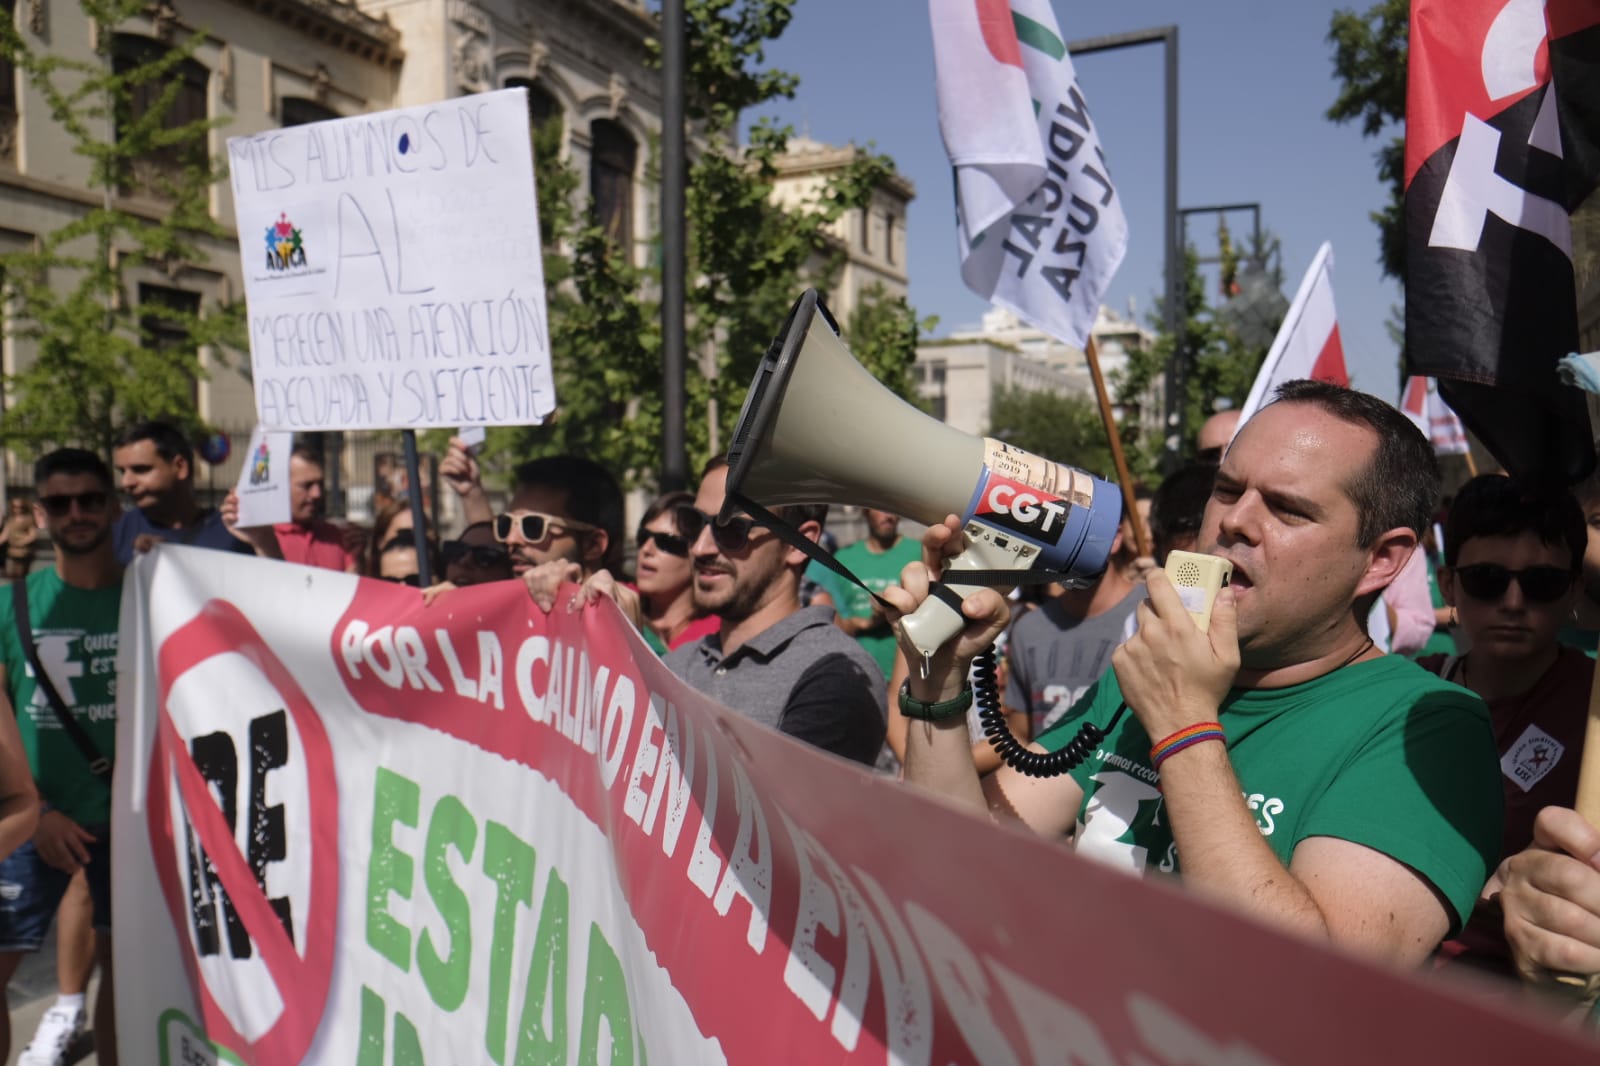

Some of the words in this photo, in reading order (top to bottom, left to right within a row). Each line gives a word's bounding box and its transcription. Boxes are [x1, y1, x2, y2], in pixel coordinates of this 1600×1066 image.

[458, 103, 500, 168] DE
[335, 188, 435, 299] AL
[352, 307, 401, 365] UNA
[408, 290, 545, 360] ATENCIÓN
[378, 371, 396, 422] Y
[403, 364, 547, 424] SUFICIENTE
[992, 450, 1004, 460] de
[1005, 454, 1030, 470] Mayo
[998, 460, 1021, 475] 2019
[988, 484, 1066, 533] CGT
[340, 619, 441, 692] POR
[437, 628, 505, 710] LA
